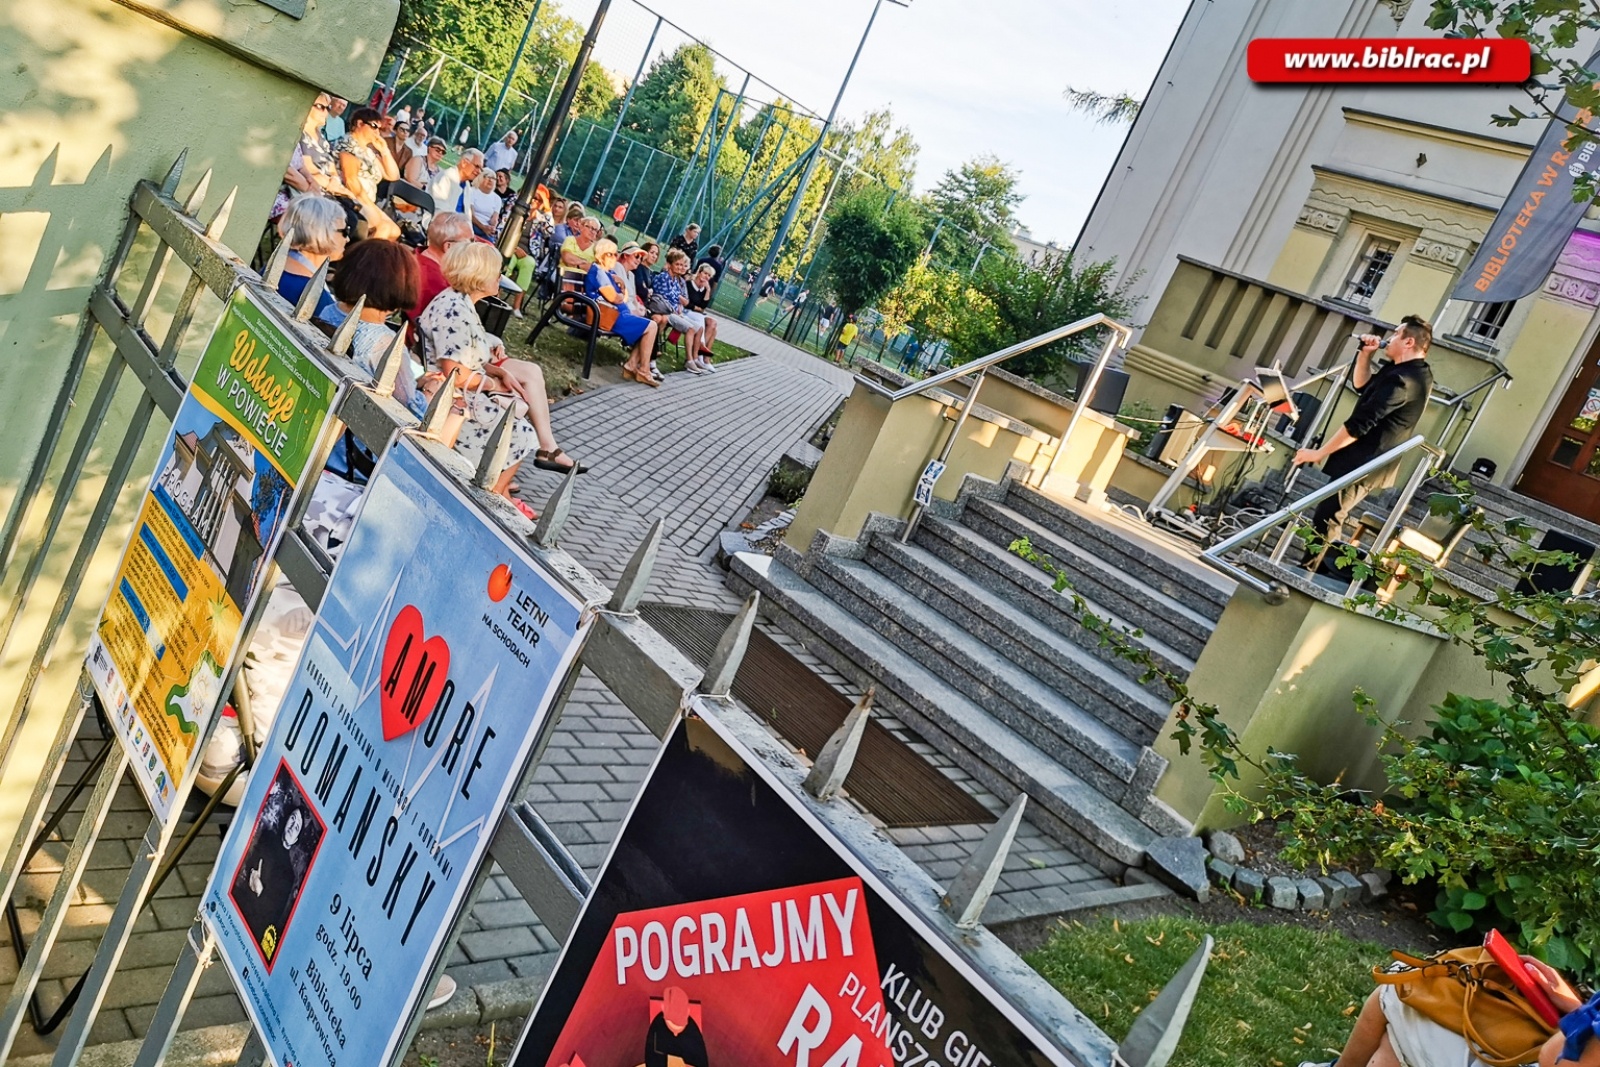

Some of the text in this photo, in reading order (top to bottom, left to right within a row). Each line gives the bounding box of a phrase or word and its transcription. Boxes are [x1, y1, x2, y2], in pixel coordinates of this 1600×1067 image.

[1474, 190, 1546, 293] BIBLIOTEKA
[1537, 164, 1558, 187] W
[216, 363, 289, 458] W POWIECIE
[229, 329, 295, 424] Wakacje
[481, 613, 531, 669] NA SCHODACH
[507, 606, 541, 649] TEATR
[516, 590, 550, 628] LETNI
[306, 659, 333, 699] KONCERT
[331, 694, 339, 708] Z
[337, 703, 375, 762] PIOSENKAMI
[374, 758, 382, 772] O
[411, 812, 419, 826] I
[384, 632, 496, 800] AMORE
[284, 687, 437, 947] DOMANSKY
[315, 923, 362, 1010] godz. 19.00
[329, 893, 373, 981] 9 lipca
[615, 888, 858, 986] POGRAJMY
[289, 966, 337, 1067] ul. Kasprowicza
[305, 957, 347, 1050] Biblioteka
[838, 971, 942, 1067] PLANSZ
[880, 962, 945, 1040] KLUB
